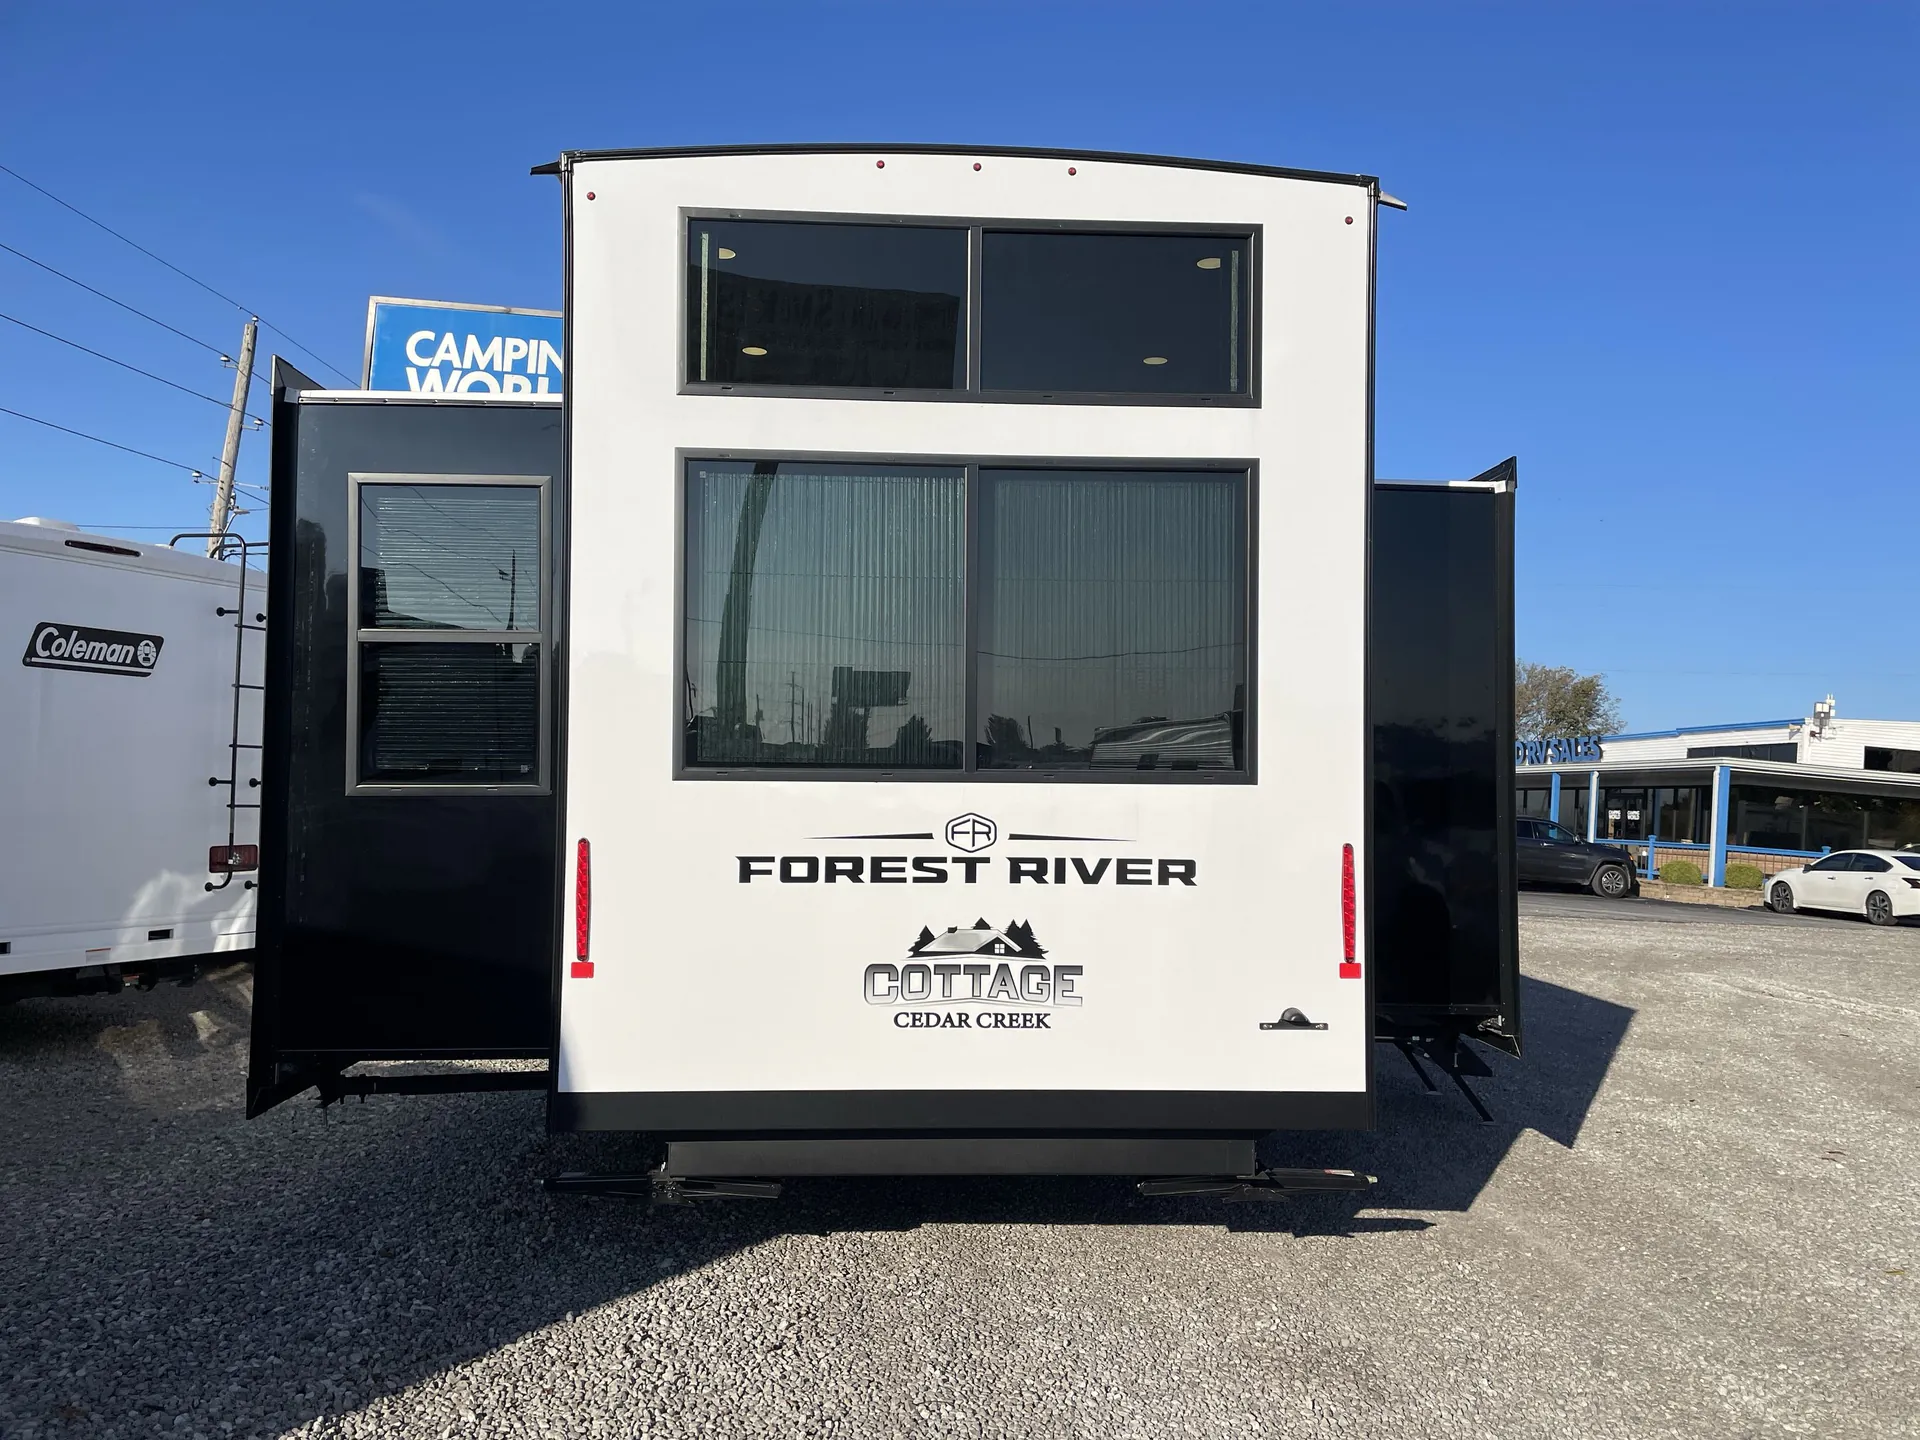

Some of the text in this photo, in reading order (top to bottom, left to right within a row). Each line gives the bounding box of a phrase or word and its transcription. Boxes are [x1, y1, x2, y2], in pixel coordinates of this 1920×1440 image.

[35, 626, 135, 664] Coleman
[1526, 741, 1547, 765] RV
[1549, 735, 1601, 763] SALES
[951, 818, 991, 847] FR
[735, 856, 1197, 886] FOREST RIVER
[864, 963, 1084, 1007] COTTAGE
[893, 1012, 1051, 1029] CEDAR CREEK
